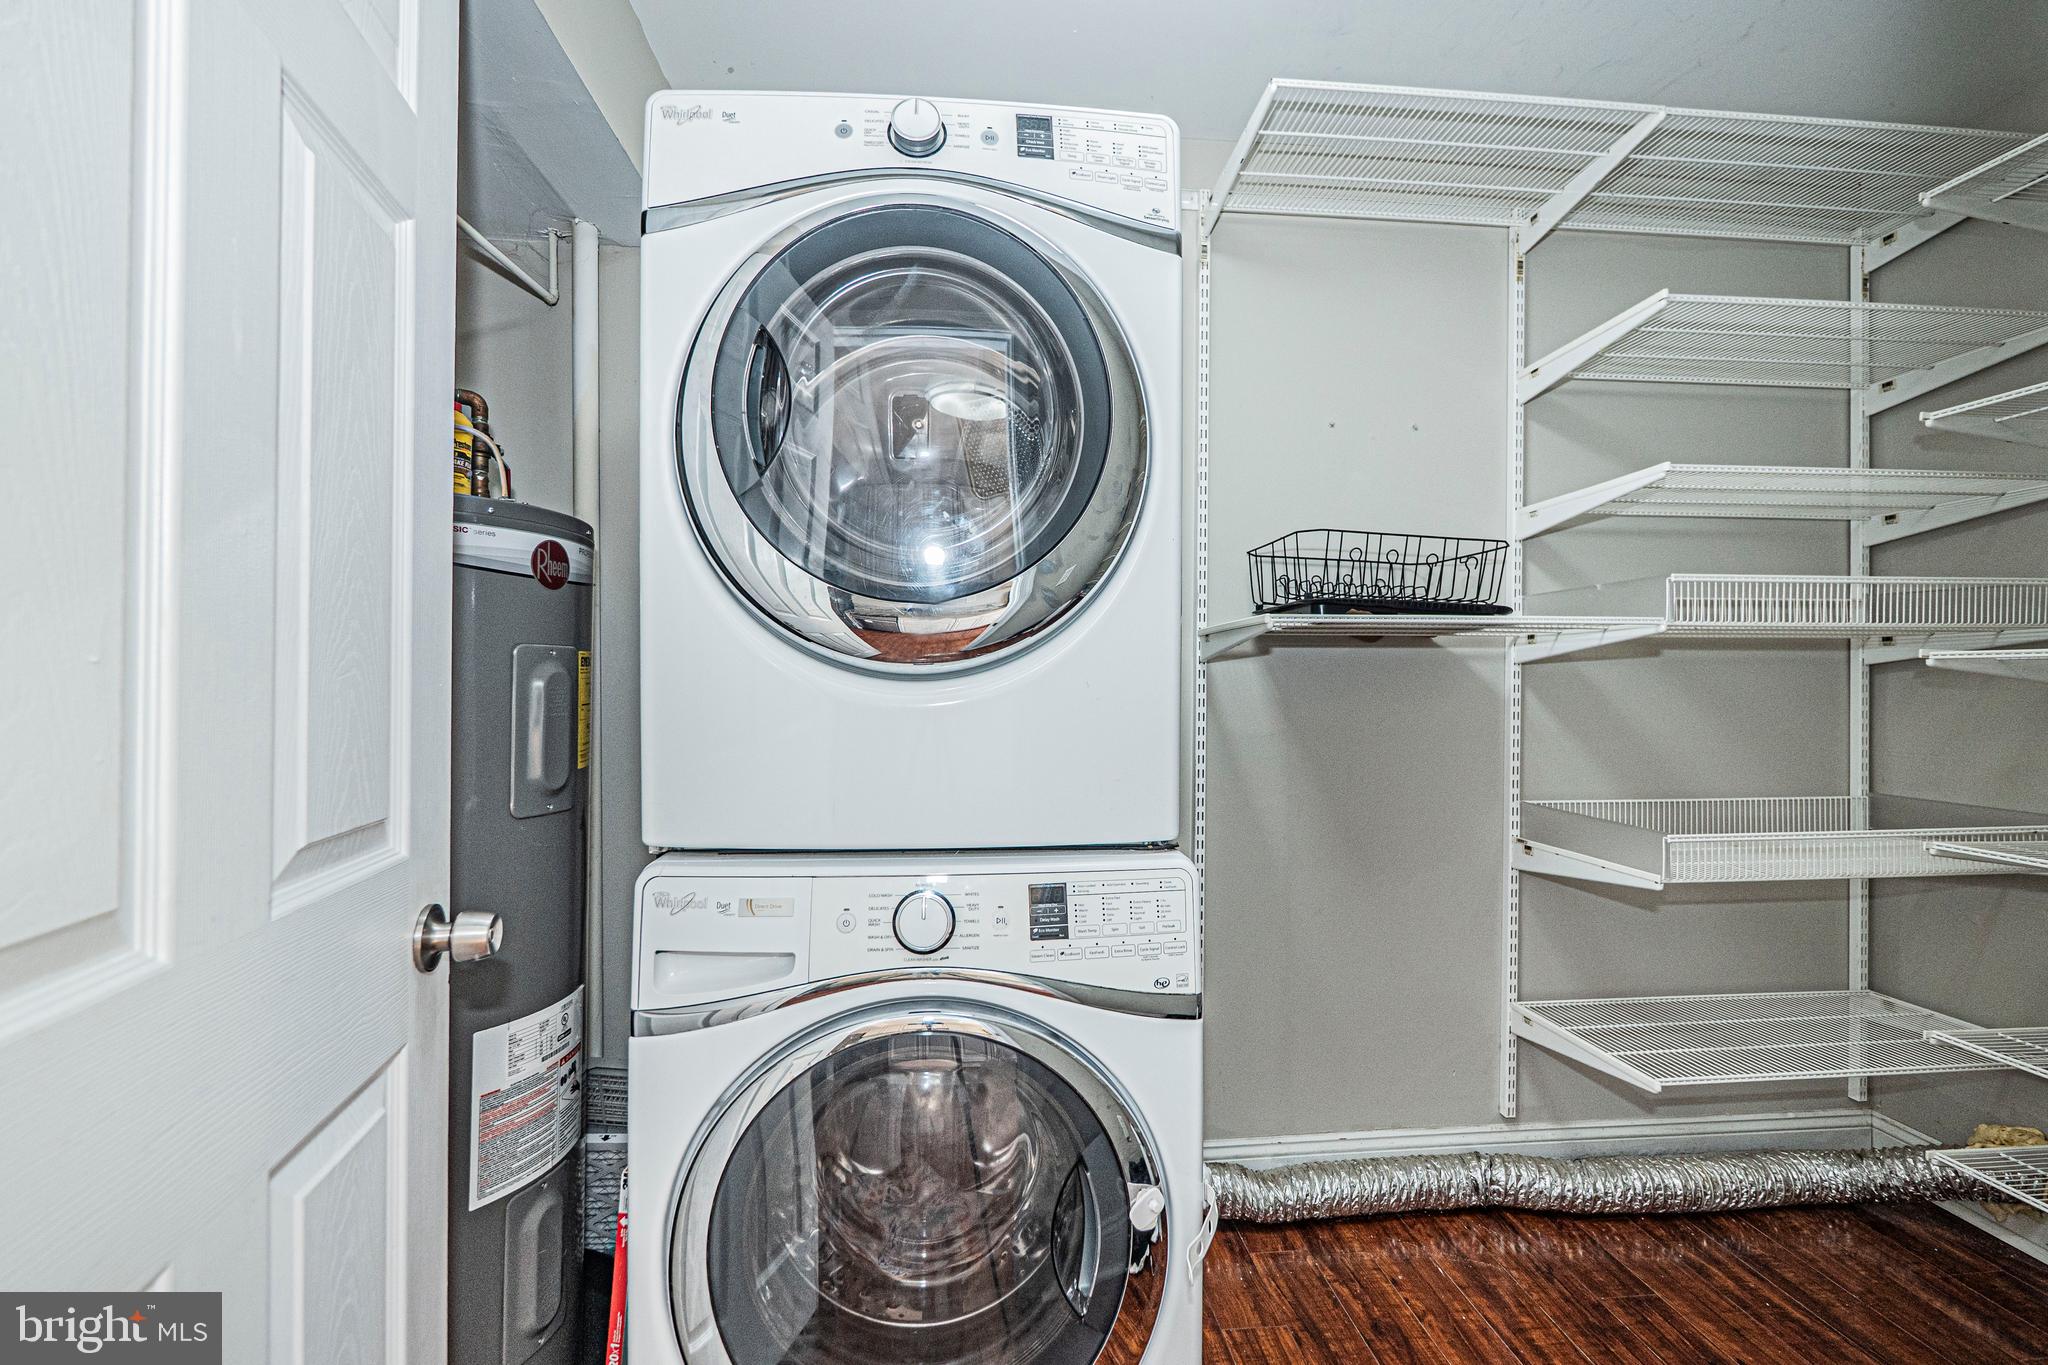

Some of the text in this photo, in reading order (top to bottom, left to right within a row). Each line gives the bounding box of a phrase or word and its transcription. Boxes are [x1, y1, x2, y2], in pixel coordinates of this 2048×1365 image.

[661, 106, 712, 124] Whirlpool
[537, 542, 569, 583] Rheem
[653, 893, 708, 913] Whirlpool
[716, 901, 731, 910] Duet
